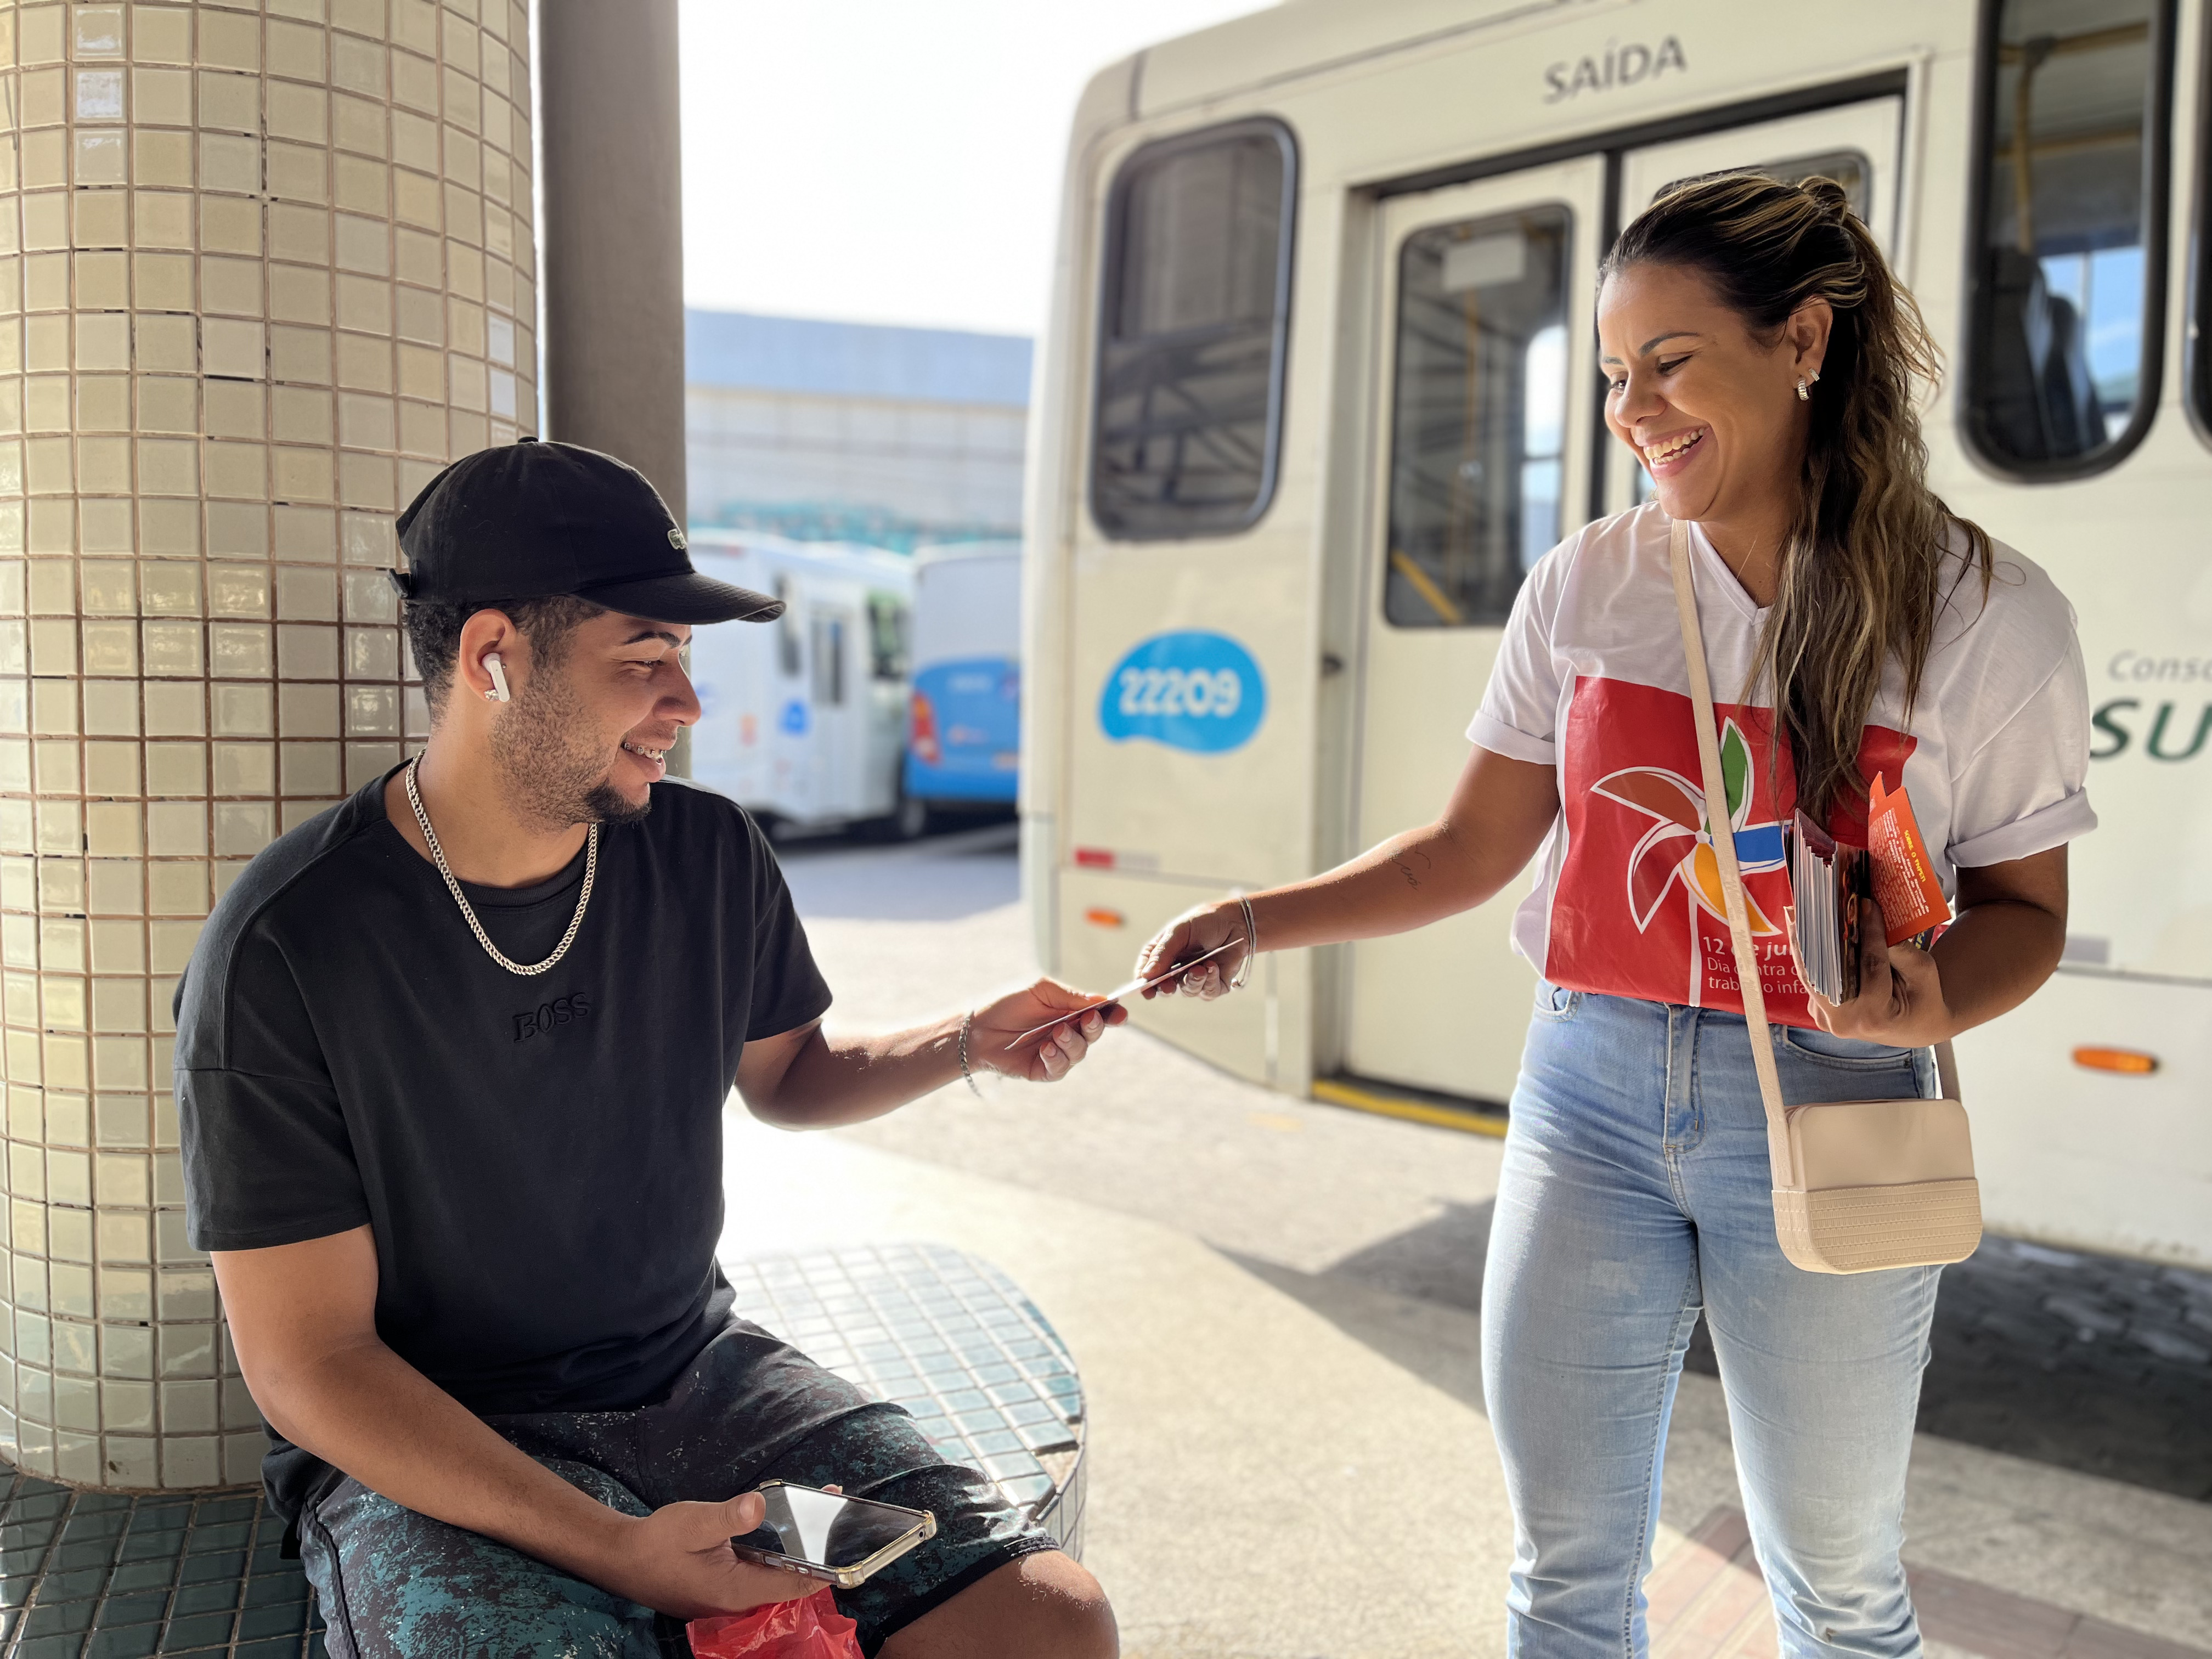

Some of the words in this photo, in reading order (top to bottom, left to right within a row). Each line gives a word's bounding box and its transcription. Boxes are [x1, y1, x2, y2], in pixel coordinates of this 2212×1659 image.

[1542, 33, 1688, 105] SAÍDA
[1119, 666, 1242, 717] 22209
[1703, 936, 1725, 955] 12
[1707, 957, 1730, 974] Dia
[1734, 963, 1786, 977] cntra
[1708, 976, 1774, 994] trabo
[511, 992, 591, 1043] BOSS
